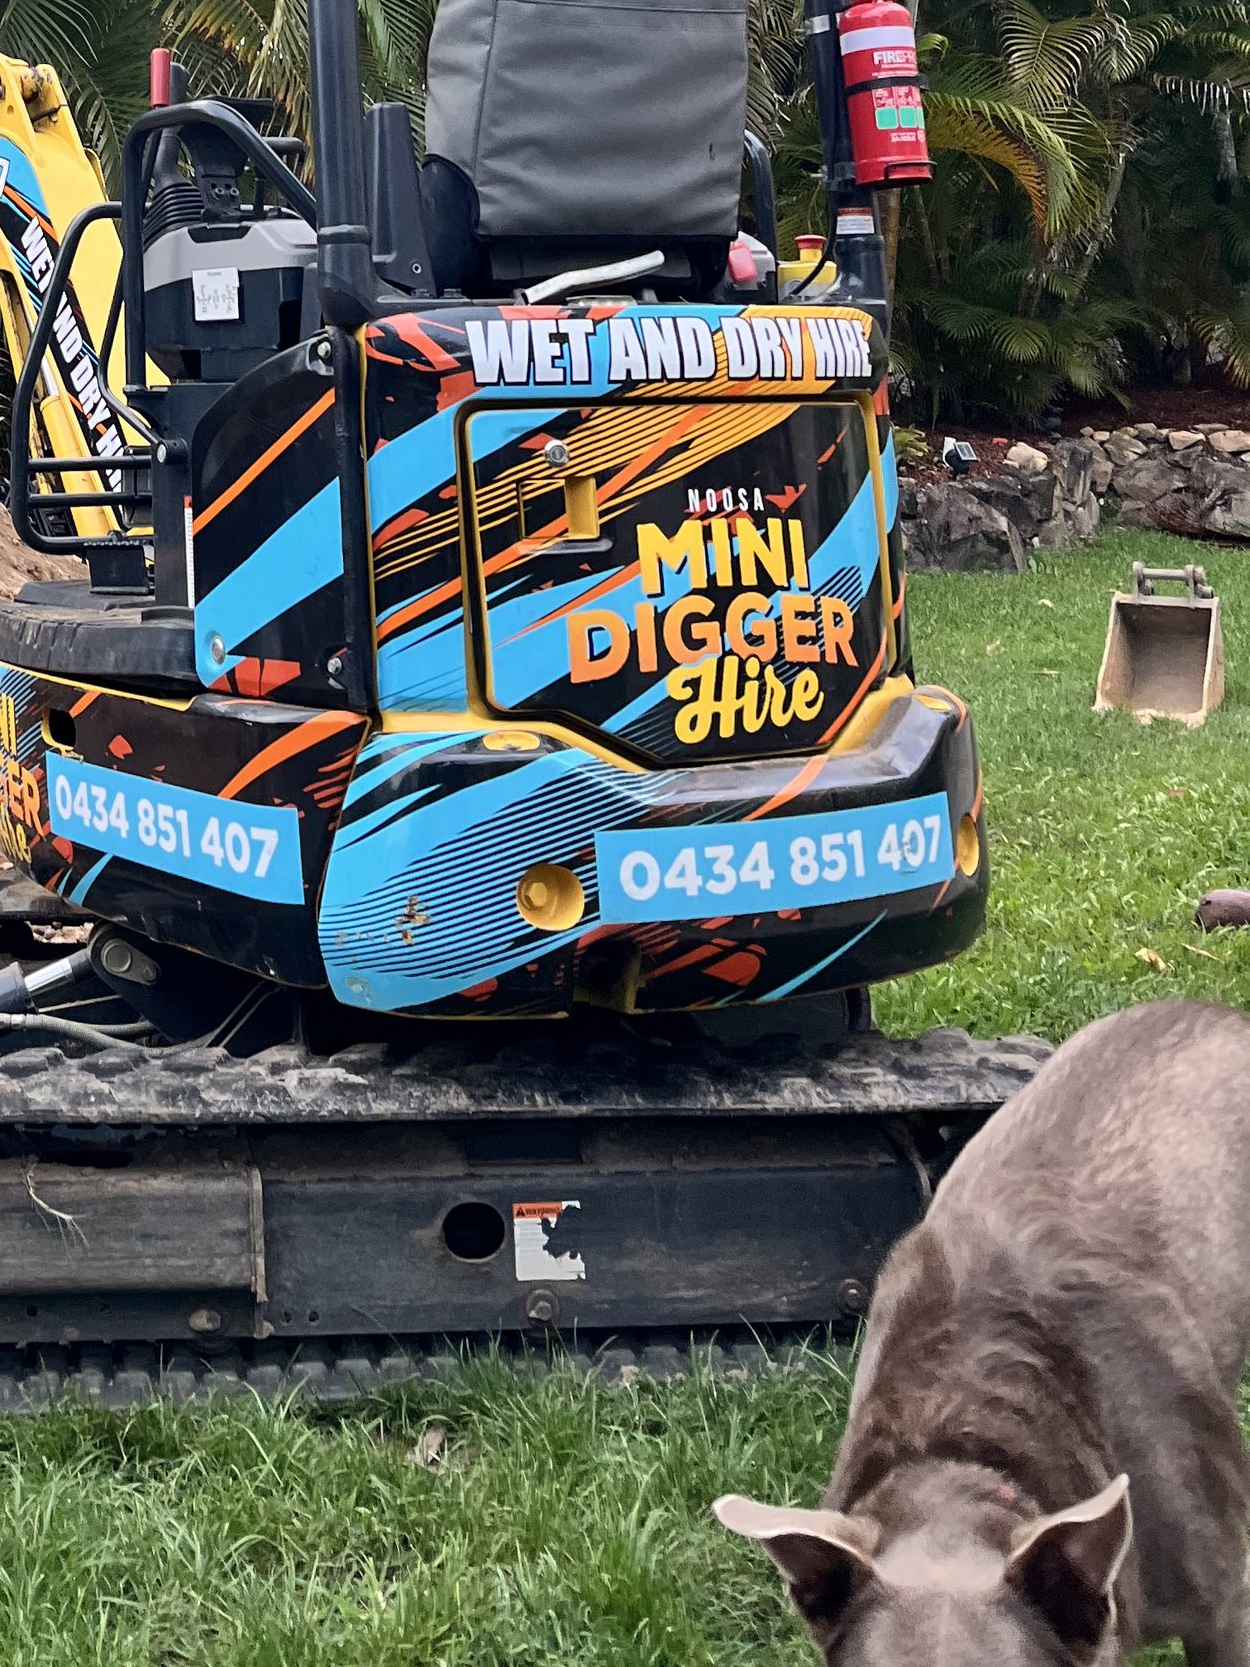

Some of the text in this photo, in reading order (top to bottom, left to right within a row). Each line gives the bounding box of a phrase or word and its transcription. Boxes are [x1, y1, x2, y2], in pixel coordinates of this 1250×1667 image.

[465, 315, 874, 385] WET AND DRY HIRE
[69, 354, 112, 431] DRY
[687, 487, 765, 513] NOOSA
[636, 517, 808, 596] MINI
[567, 592, 858, 684] DIGGER
[667, 655, 825, 746] Hire
[54, 773, 279, 879] 0434 851 407
[619, 814, 942, 901] 0434 851 407
